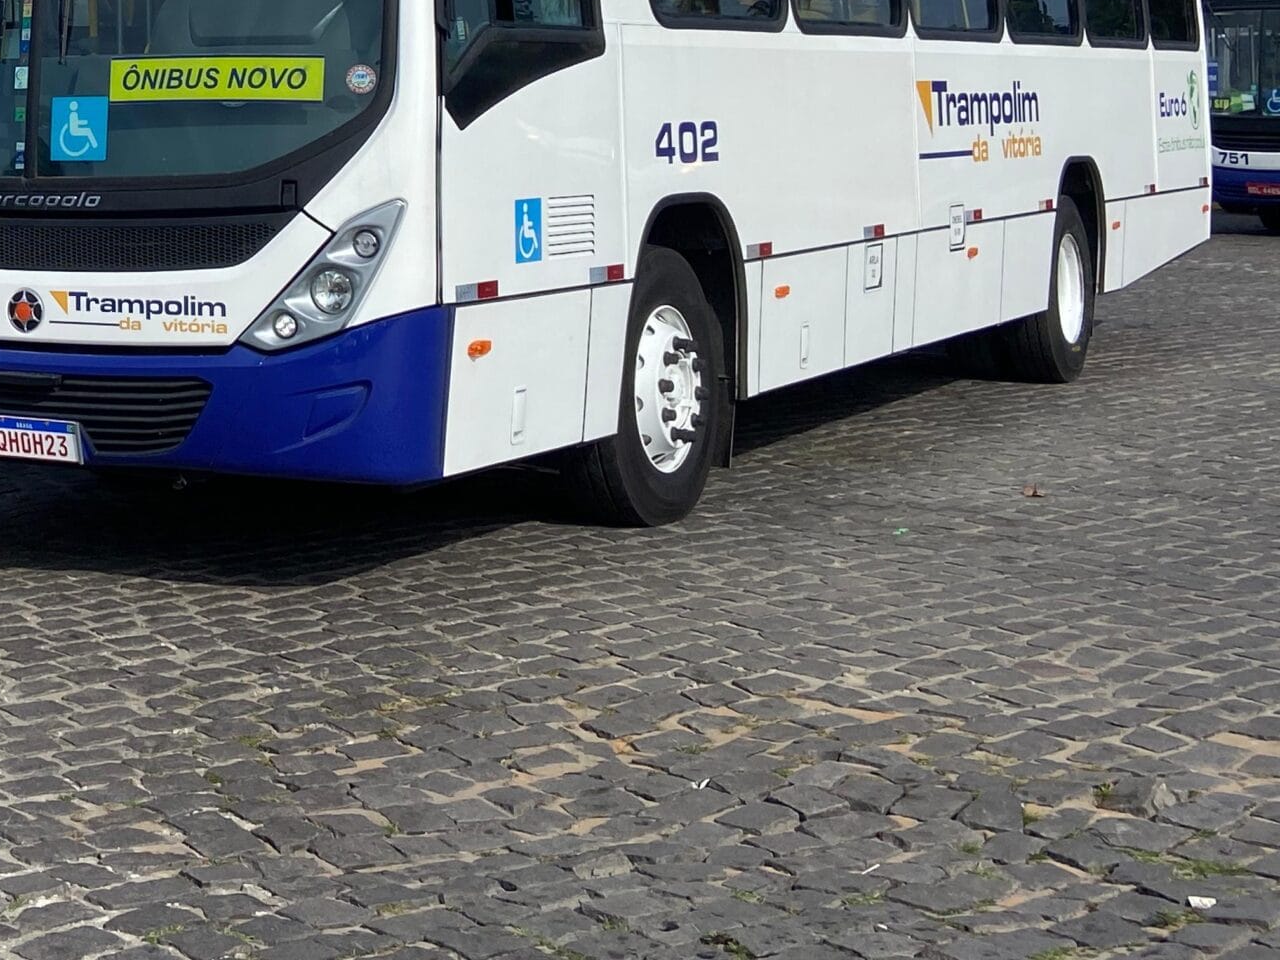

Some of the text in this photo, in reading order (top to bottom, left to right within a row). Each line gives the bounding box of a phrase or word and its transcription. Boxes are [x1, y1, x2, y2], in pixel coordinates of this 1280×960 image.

[122, 64, 308, 90] ÔNIBUS NOVO
[931, 80, 1040, 137] Trampolim
[655, 120, 719, 164] 402
[972, 127, 1042, 162] da vitória
[1218, 152, 1249, 166] 751
[69, 291, 226, 319] Trampolim
[119, 317, 228, 334] da vitória
